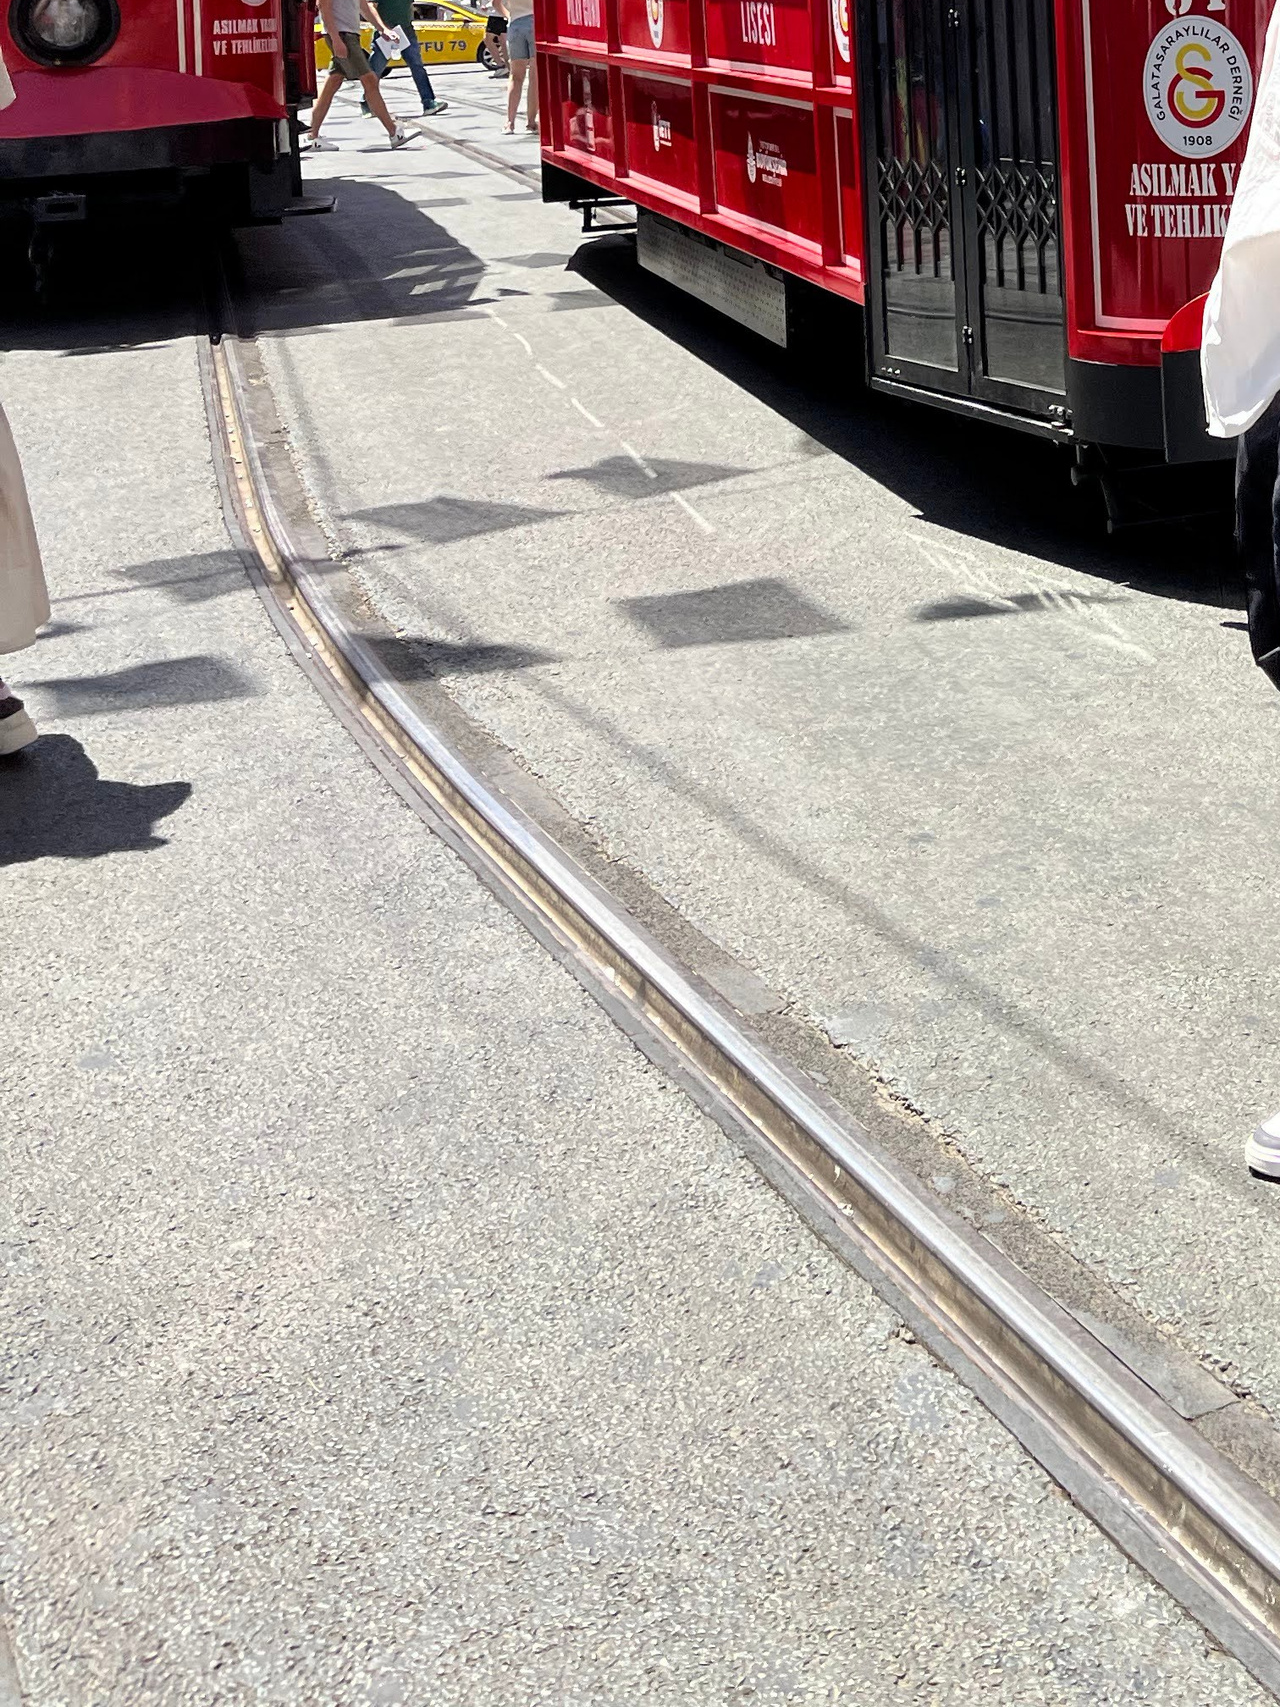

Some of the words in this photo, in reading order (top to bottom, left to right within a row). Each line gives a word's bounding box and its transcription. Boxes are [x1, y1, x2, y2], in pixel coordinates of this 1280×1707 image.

[213, 40, 228, 56] VE
[449, 39, 467, 52] 79
[1151, 25, 1231, 121] GALATASARAYLILAR
[1183, 135, 1213, 146] 1908
[1129, 162, 1218, 197] ASILMAK
[1124, 203, 1148, 238] VE
[1150, 203, 1232, 238] TEHLIK
